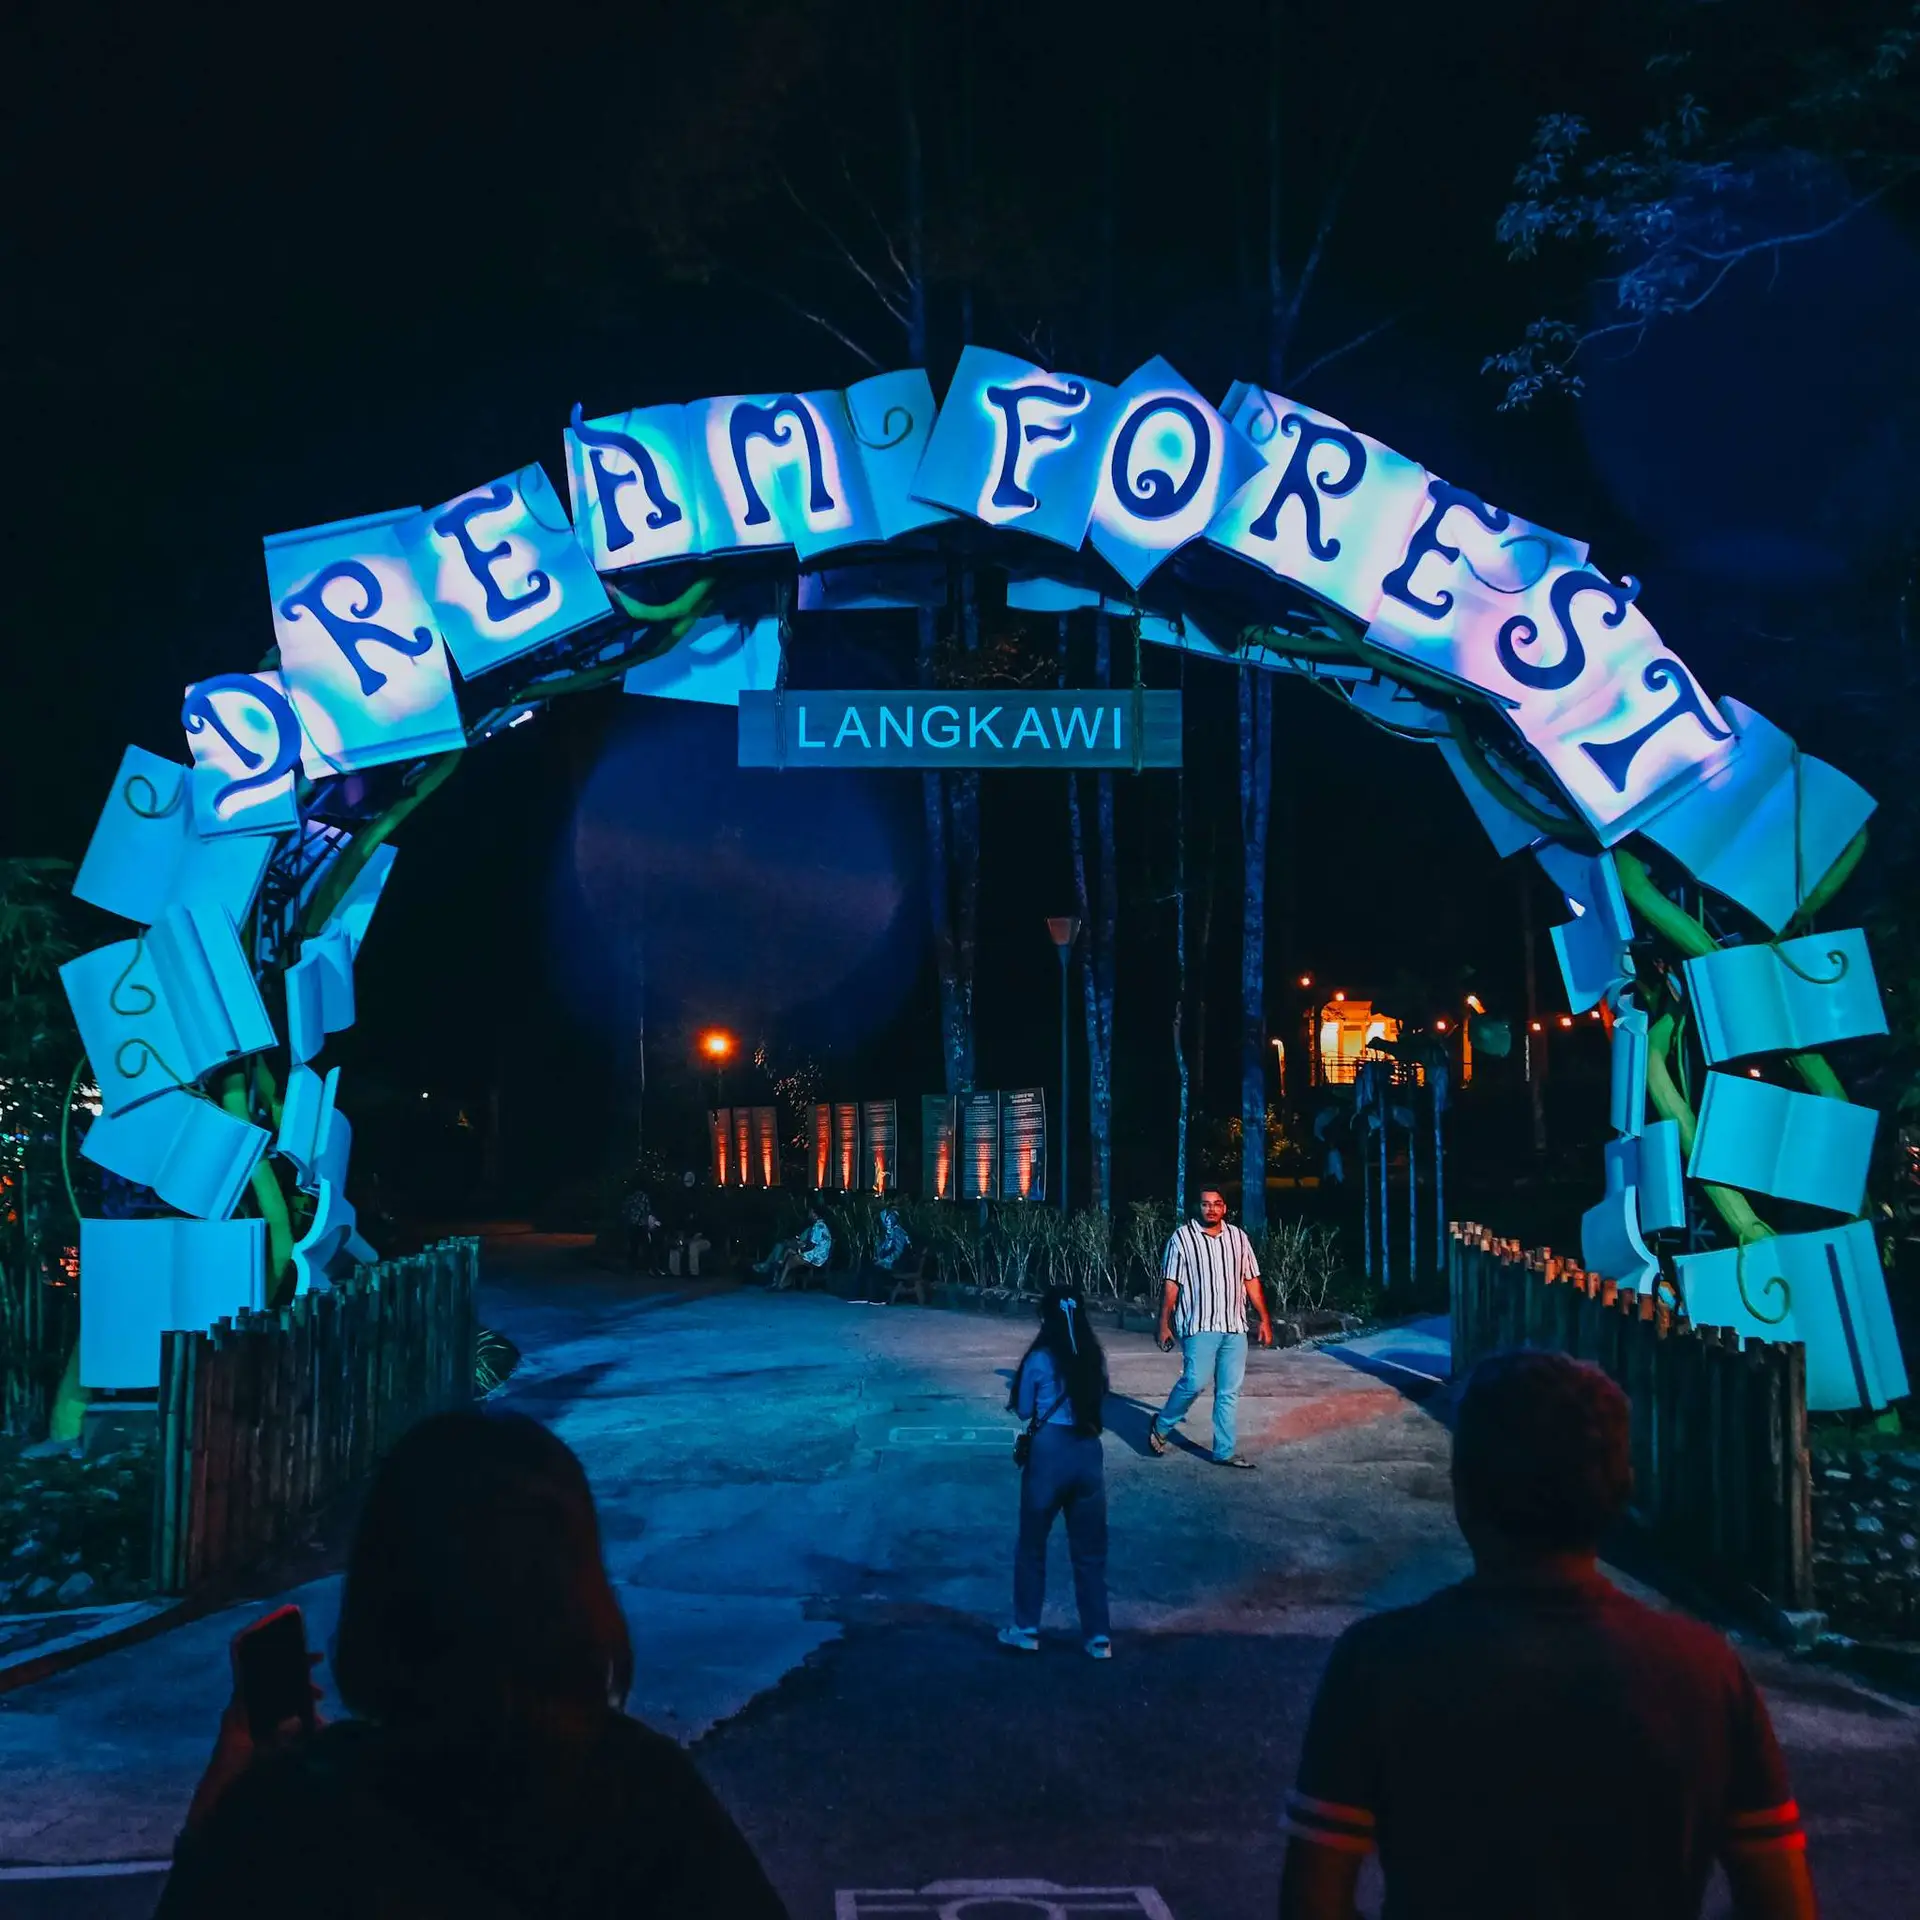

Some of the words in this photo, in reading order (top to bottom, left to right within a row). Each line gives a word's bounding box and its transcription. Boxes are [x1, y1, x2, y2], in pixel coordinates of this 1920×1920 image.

[181, 393, 835, 820] DREAM
[986, 381, 1736, 793] FOREST
[798, 705, 1122, 750] LANGKAWI
